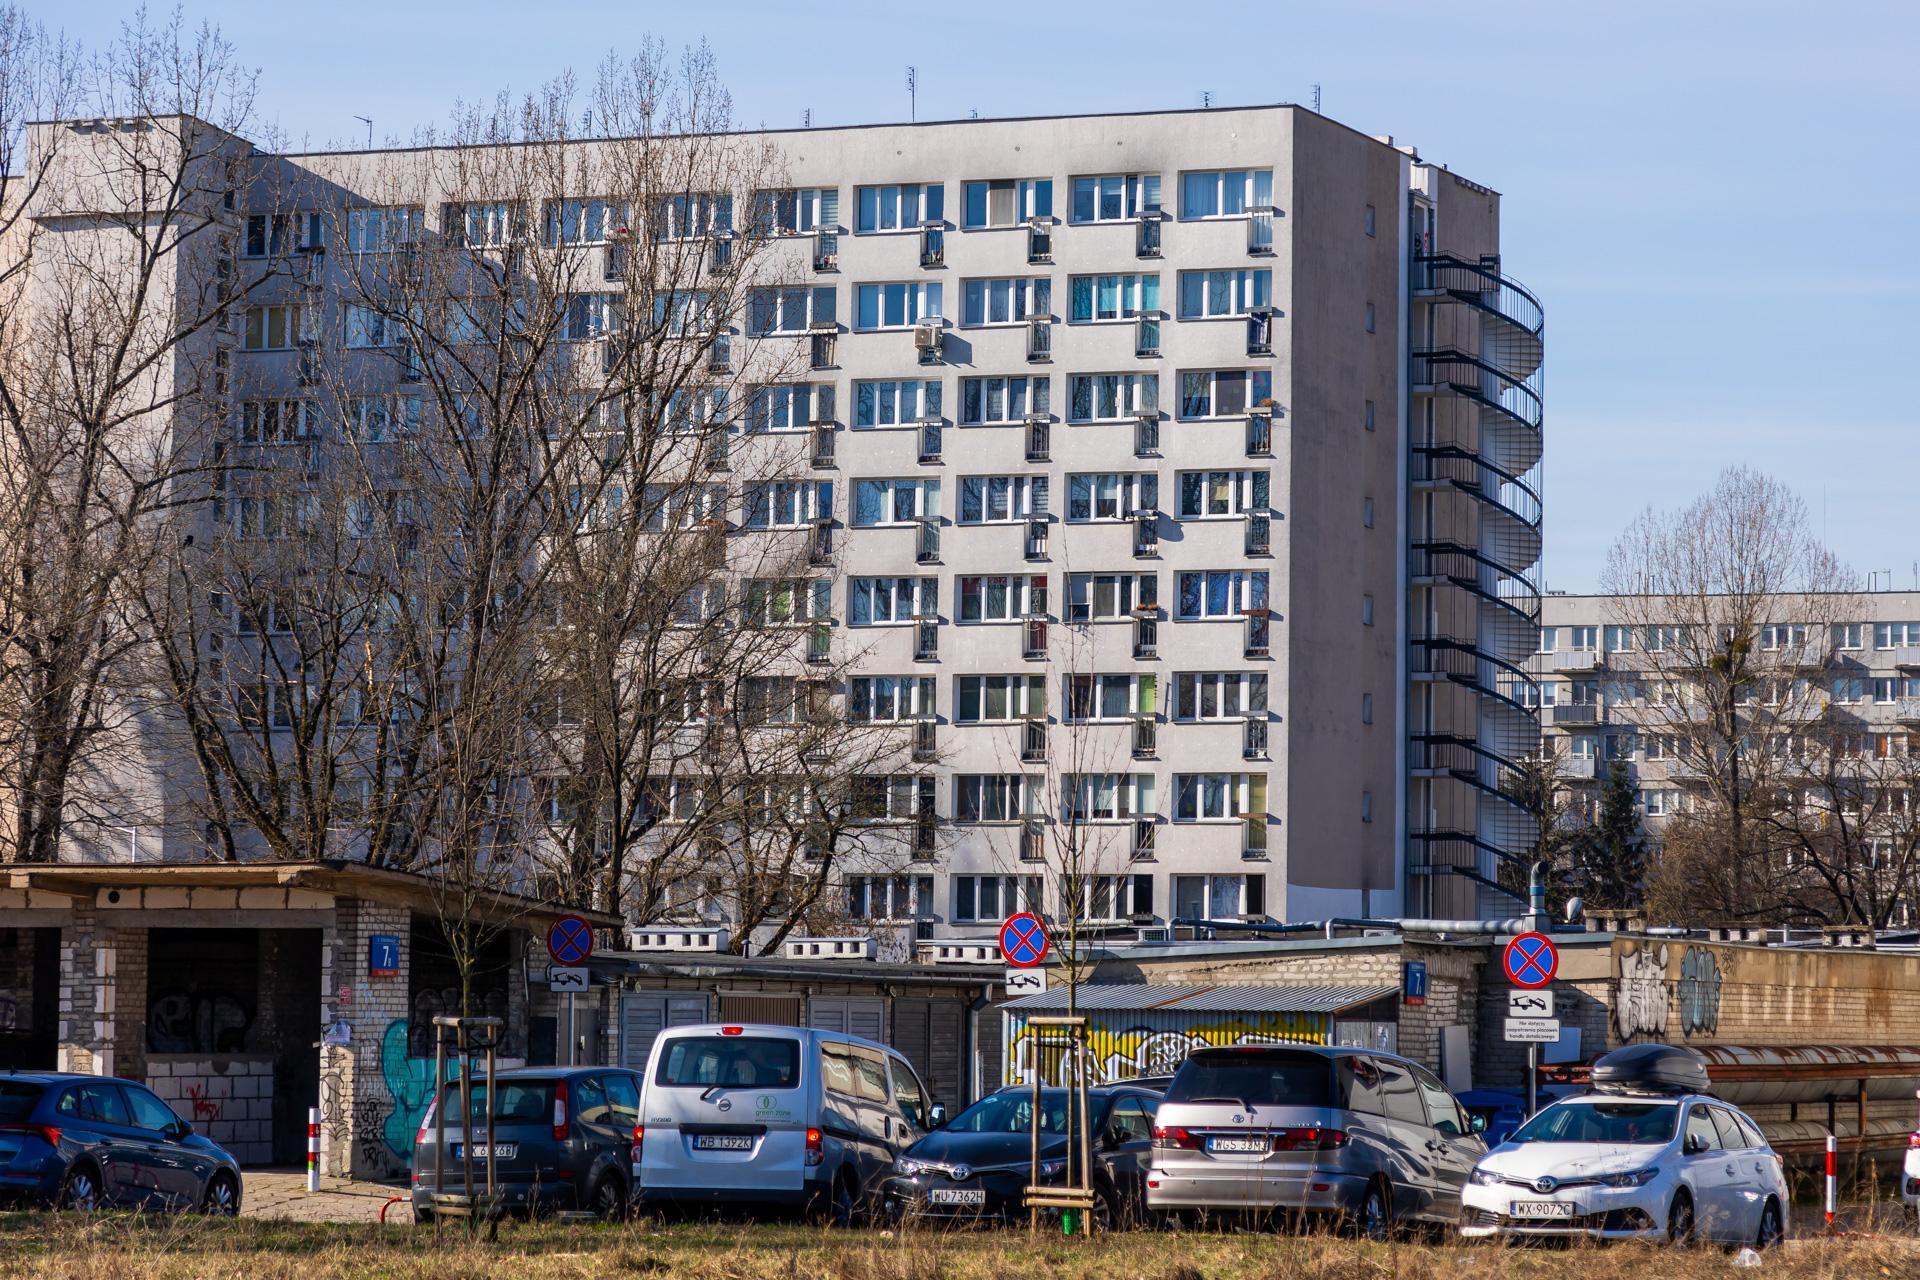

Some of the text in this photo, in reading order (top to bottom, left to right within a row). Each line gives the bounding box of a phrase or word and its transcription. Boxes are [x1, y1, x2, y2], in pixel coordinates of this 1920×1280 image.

[700, 1136, 750, 1148] WB 1392K
[1215, 1140, 1237, 1151] WGS
[481, 1145, 513, 1157] 6268
[934, 1191, 983, 1203] WU 7362H
[1518, 1203, 1571, 1216] WX 9072C
